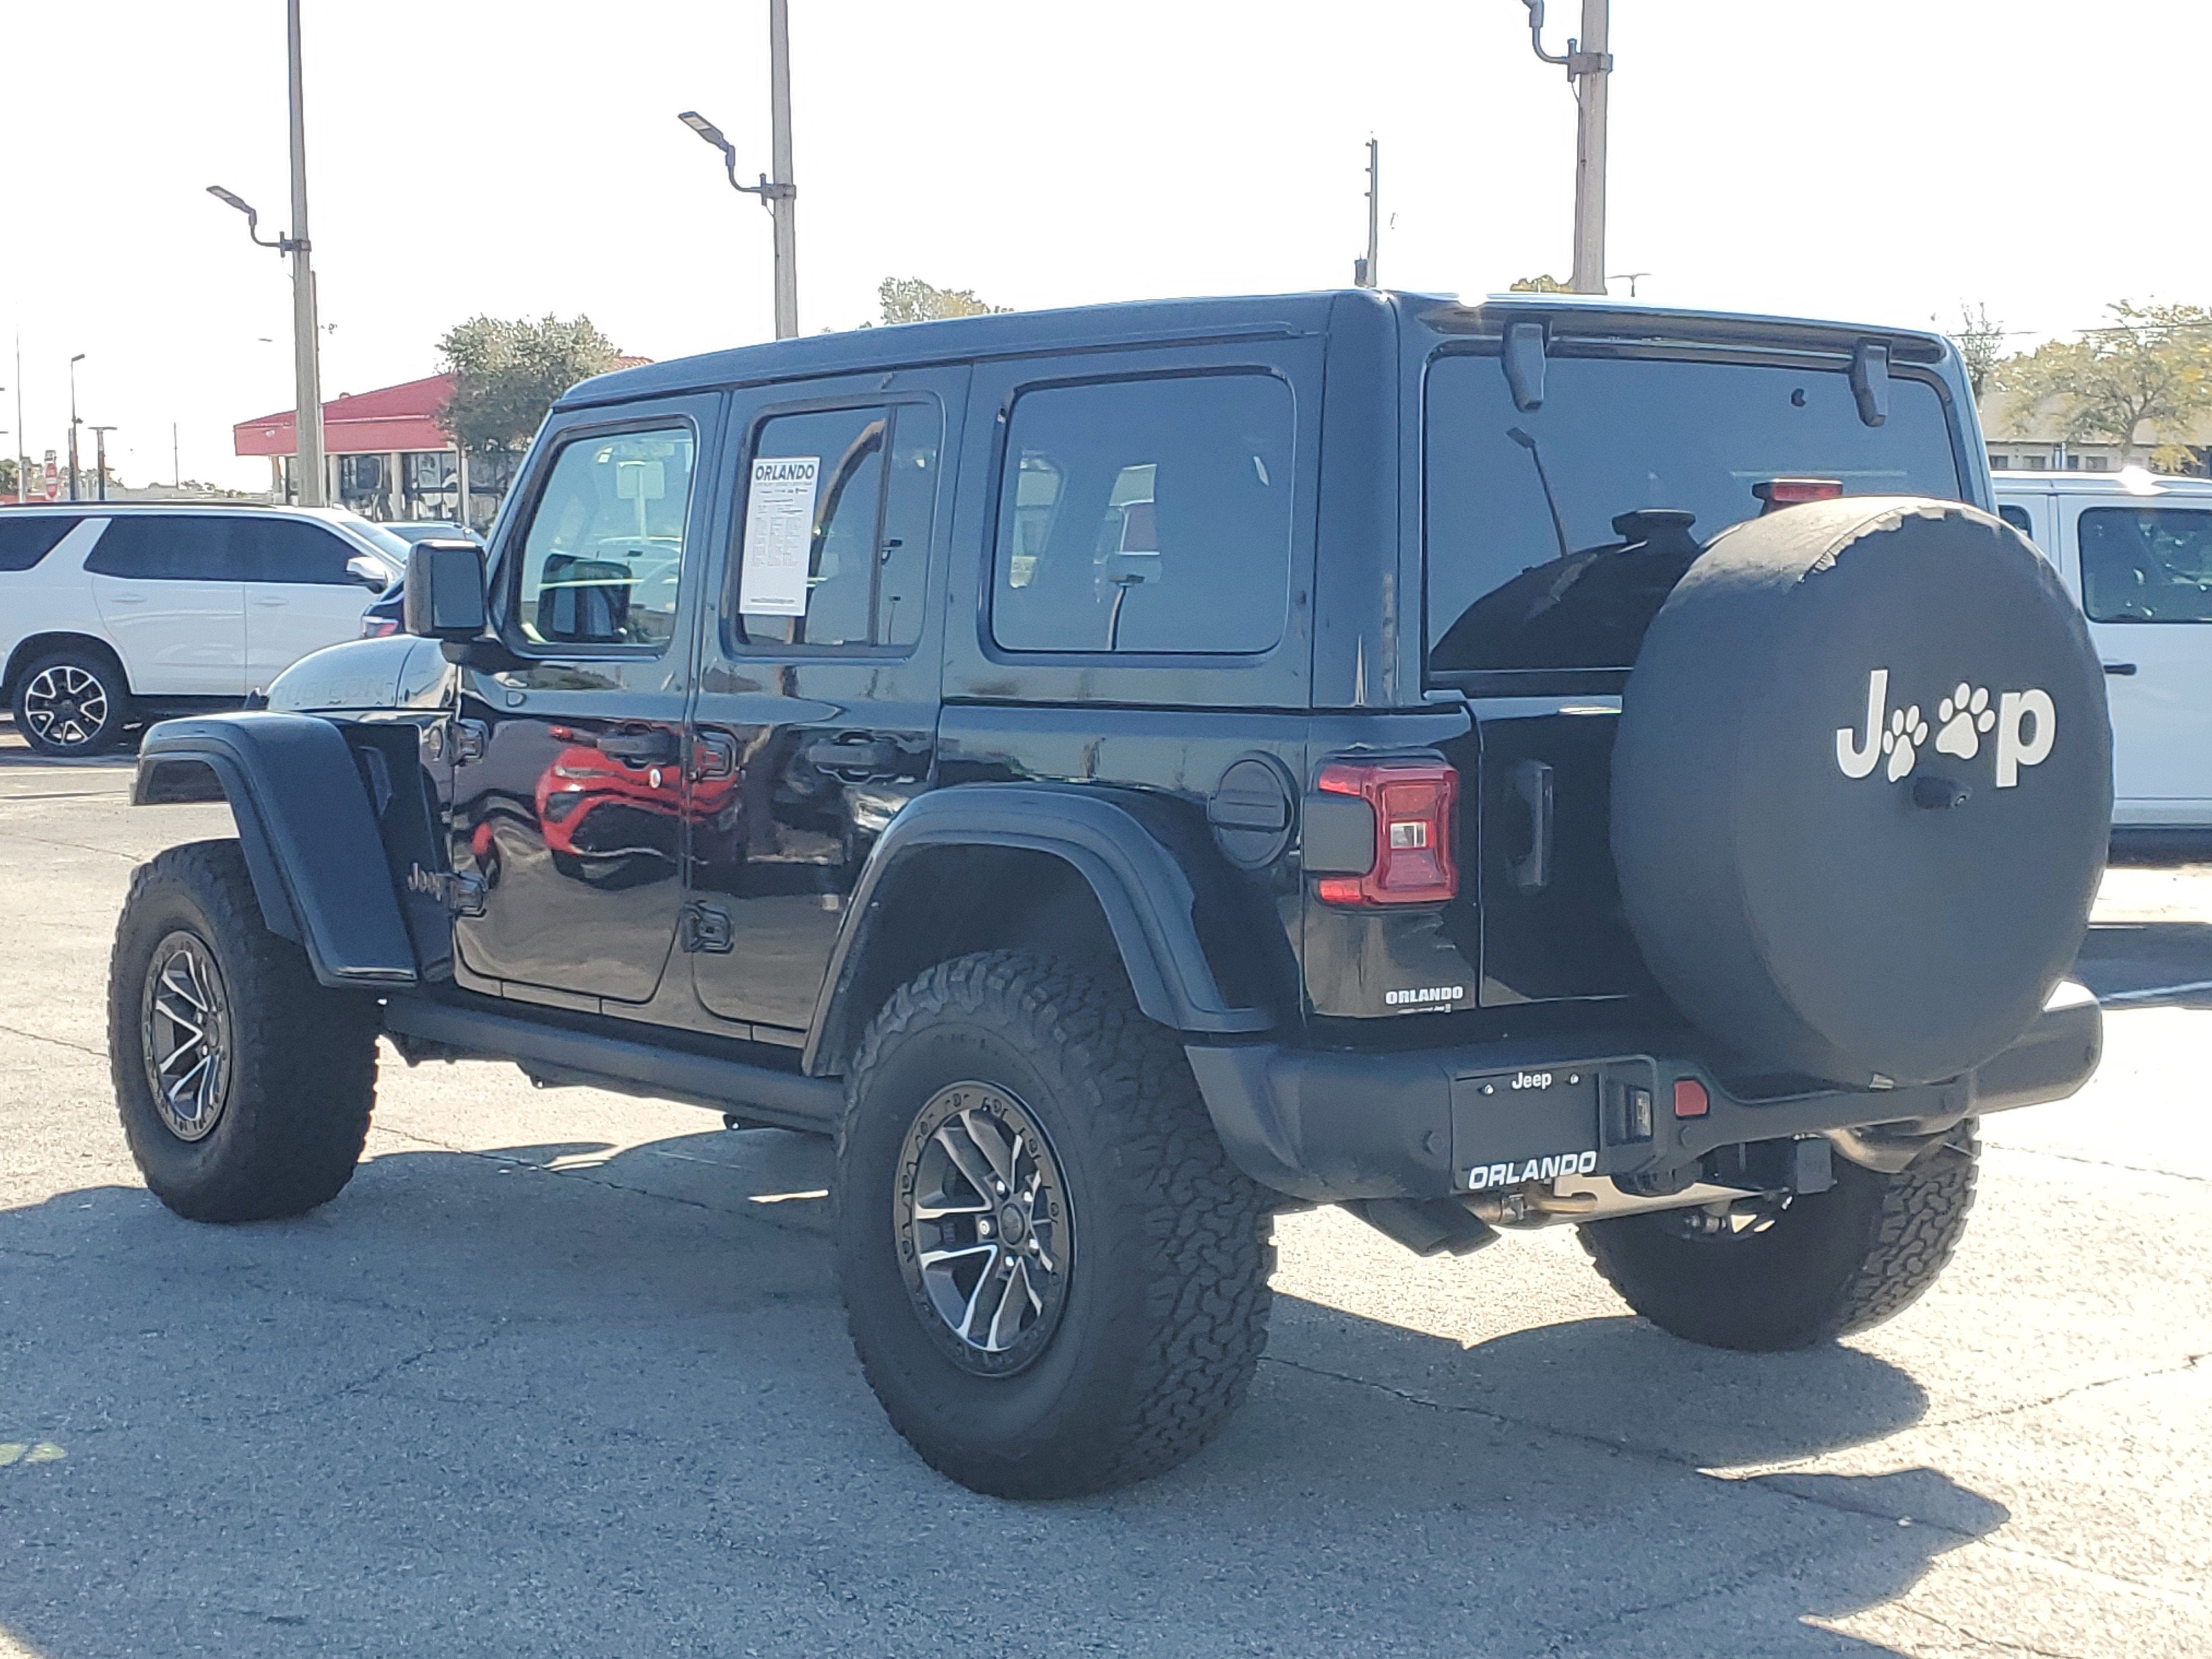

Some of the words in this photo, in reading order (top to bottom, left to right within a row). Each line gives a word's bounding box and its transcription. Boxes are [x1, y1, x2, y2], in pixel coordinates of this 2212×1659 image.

[755, 464, 815, 481] ORLANDO
[408, 862, 441, 901] Jeep
[1385, 986, 1463, 1004] ORLANDO
[1511, 1072, 1552, 1090] Jeep
[1468, 1150, 1597, 1190] ORLANDO
